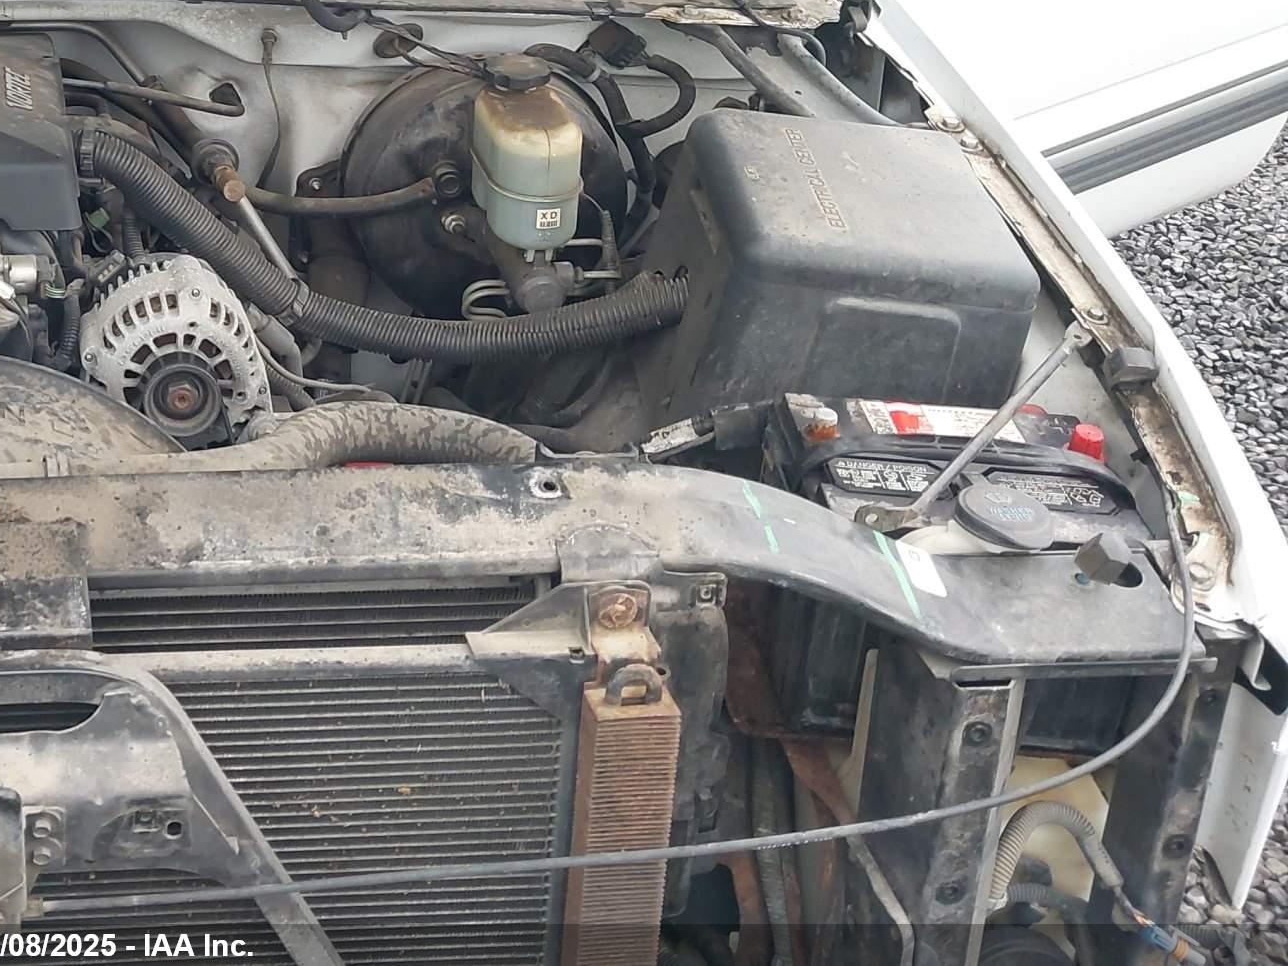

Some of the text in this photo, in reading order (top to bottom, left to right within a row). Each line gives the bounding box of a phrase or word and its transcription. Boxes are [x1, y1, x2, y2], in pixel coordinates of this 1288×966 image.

[4, 65, 34, 111] VORTEC
[784, 127, 848, 230] ELECTRICAL CENTER
